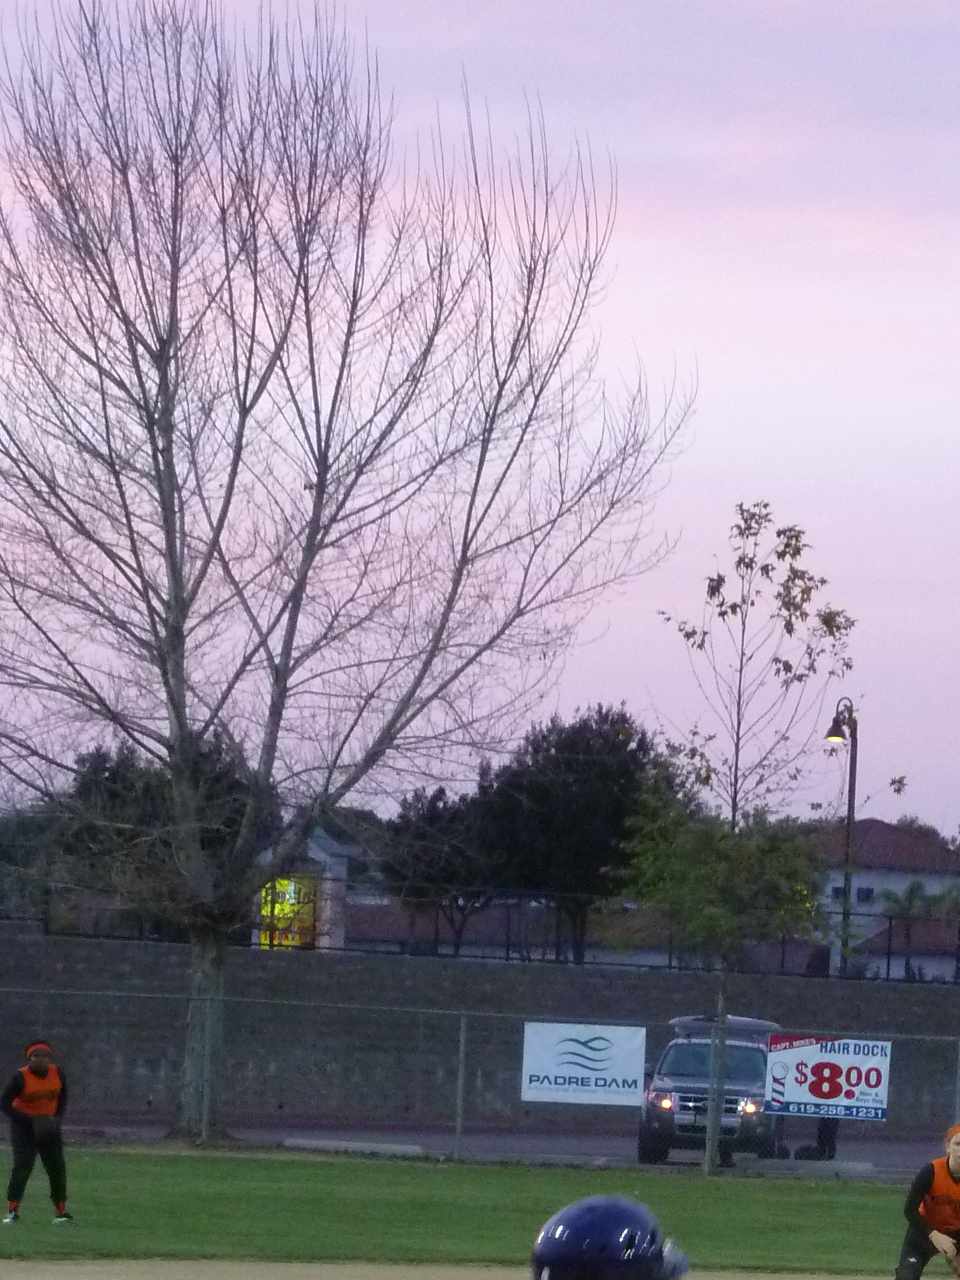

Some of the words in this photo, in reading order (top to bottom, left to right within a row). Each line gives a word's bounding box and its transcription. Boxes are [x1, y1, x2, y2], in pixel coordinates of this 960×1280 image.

[819, 1042, 850, 1056] HAIR
[853, 1044, 888, 1057] DOCK
[528, 1073, 591, 1088] PADRE
[594, 1077, 639, 1089] DAM
